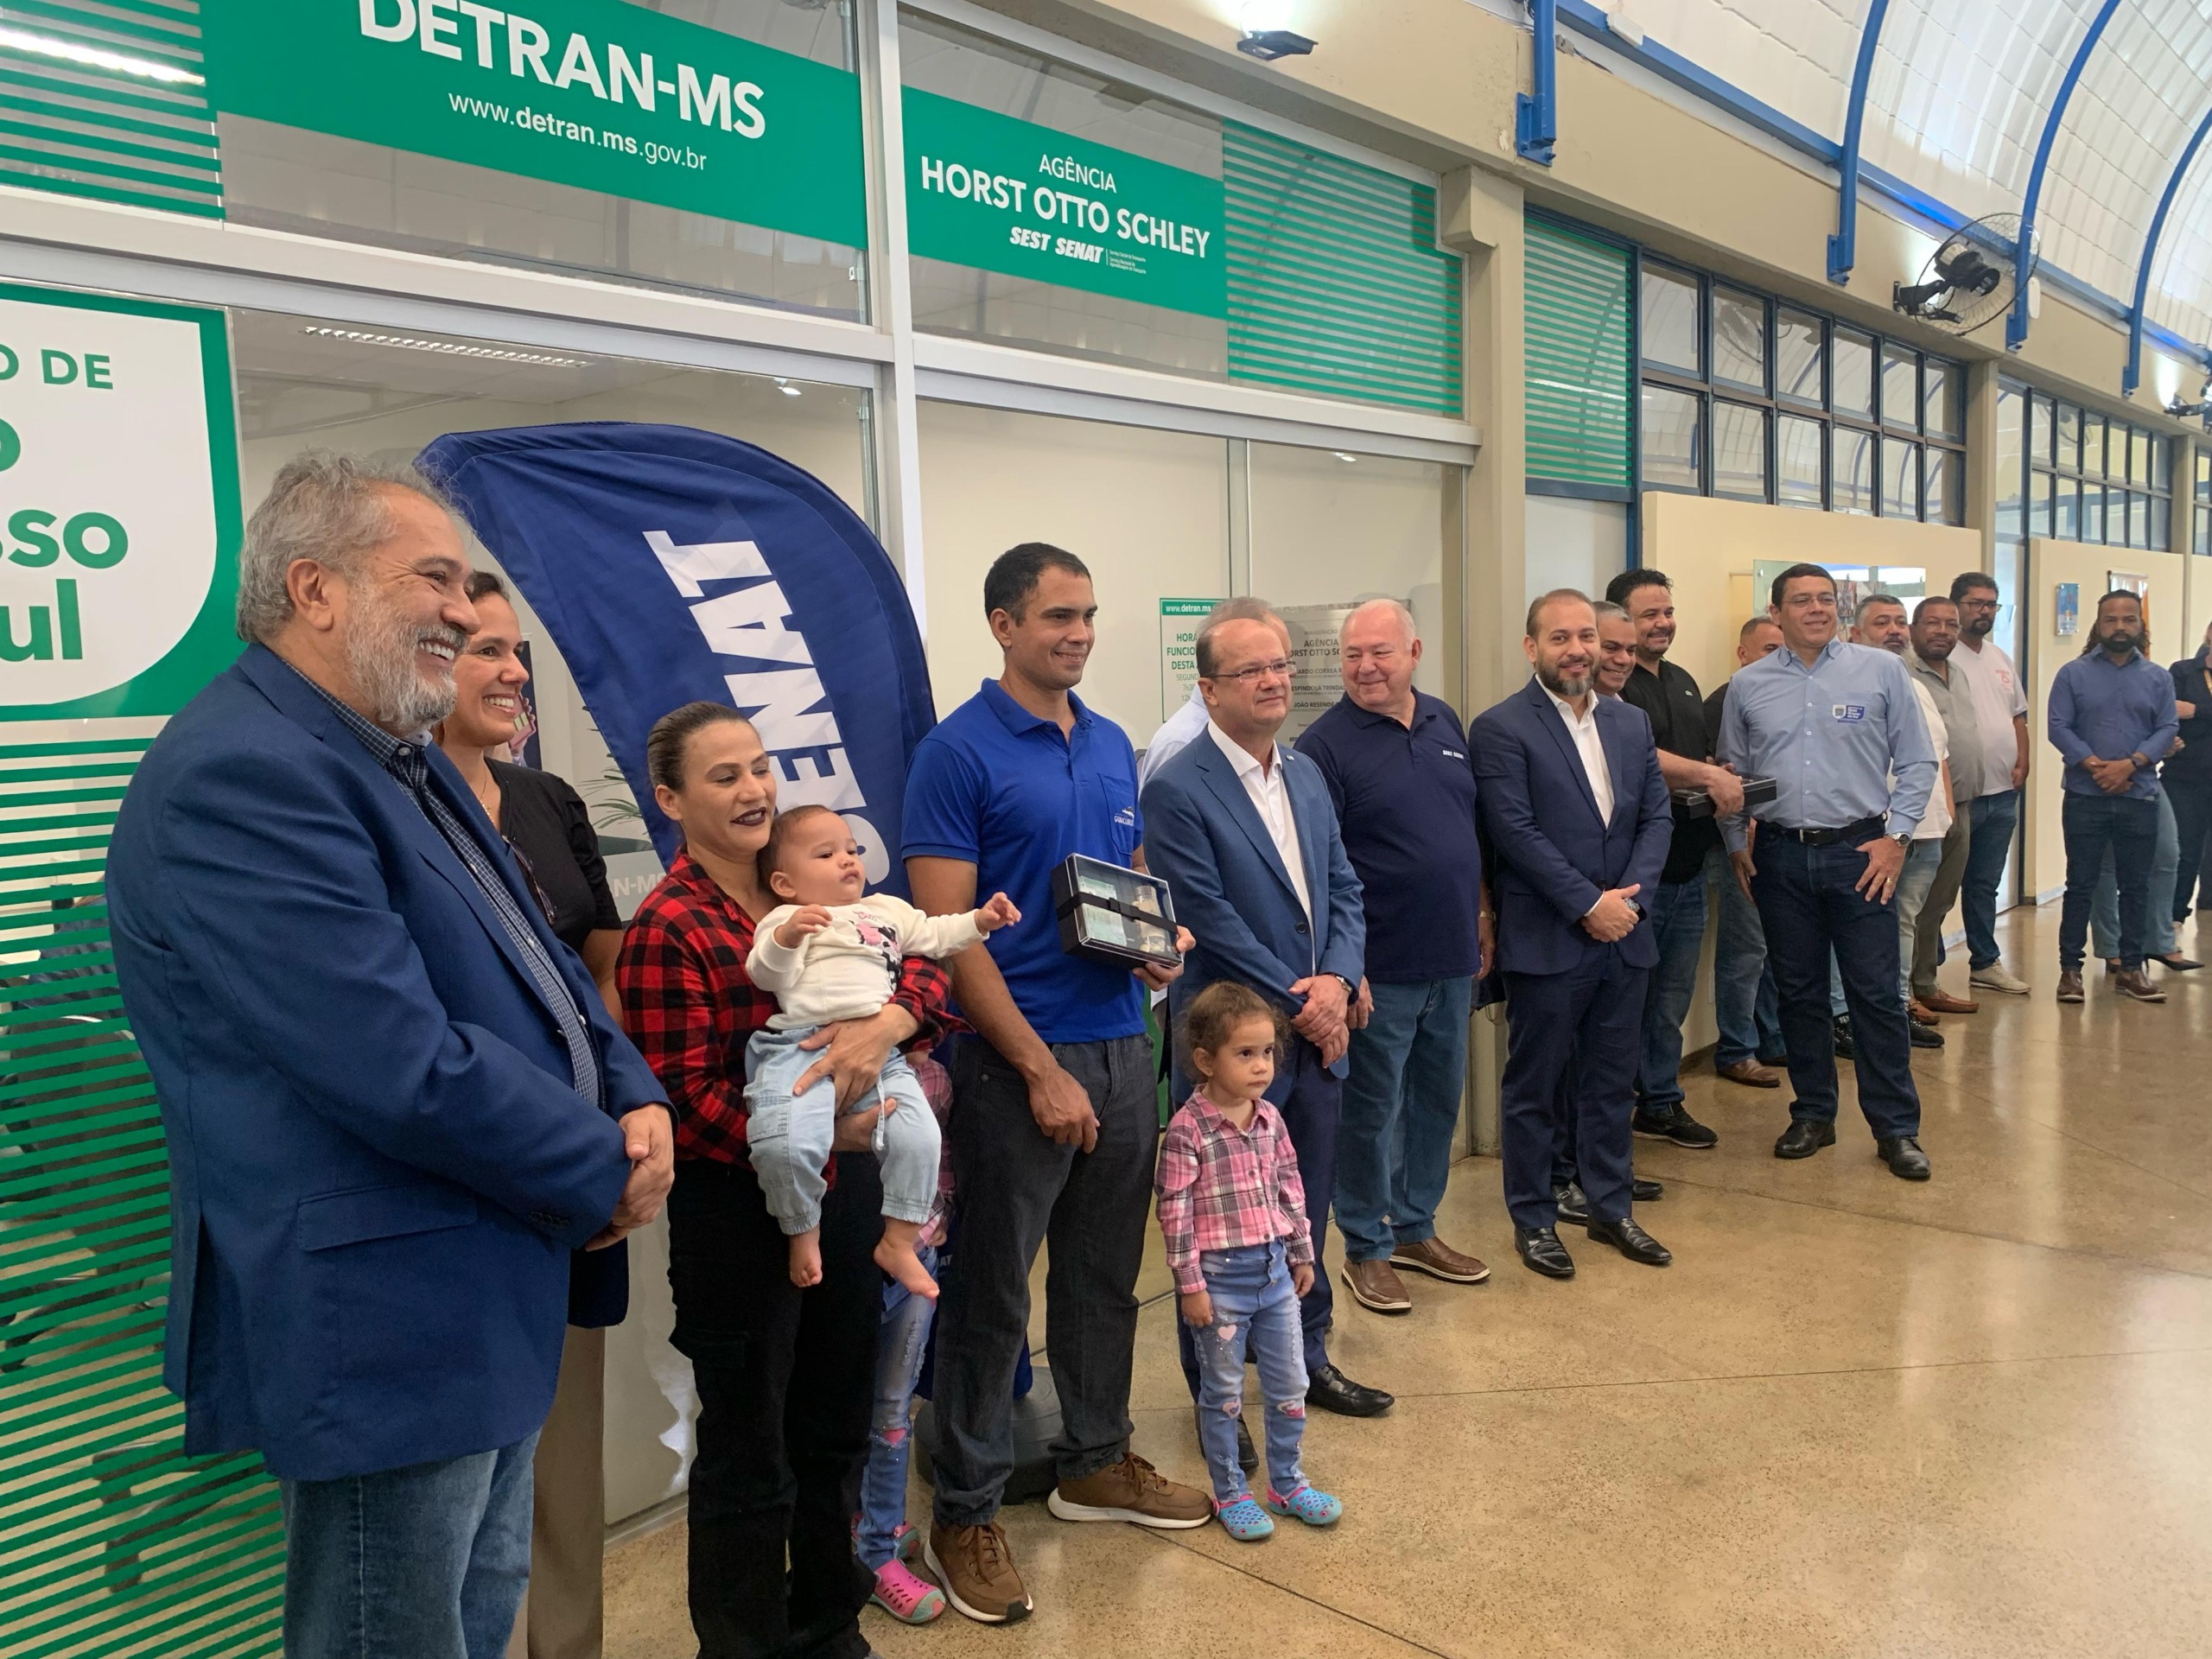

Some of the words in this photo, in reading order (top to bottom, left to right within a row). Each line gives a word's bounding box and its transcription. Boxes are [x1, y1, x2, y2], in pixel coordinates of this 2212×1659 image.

[359, 0, 766, 139] DETRAN-MS
[448, 92, 707, 171] www.detran.ms.gov.br
[1039, 154, 1117, 194] AGÊNCIA
[921, 156, 1027, 213] HORST
[1033, 187, 1109, 233] OTTO
[1116, 207, 1211, 258] SCHLEY
[1009, 226, 1052, 251] SEST
[1055, 238, 1104, 264] SENAT
[41, 348, 113, 390] DE
[1304, 638, 1339, 648] AGÊNCIA
[1309, 648, 1331, 657] OTTO
[1172, 660, 1195, 670] DESTA
